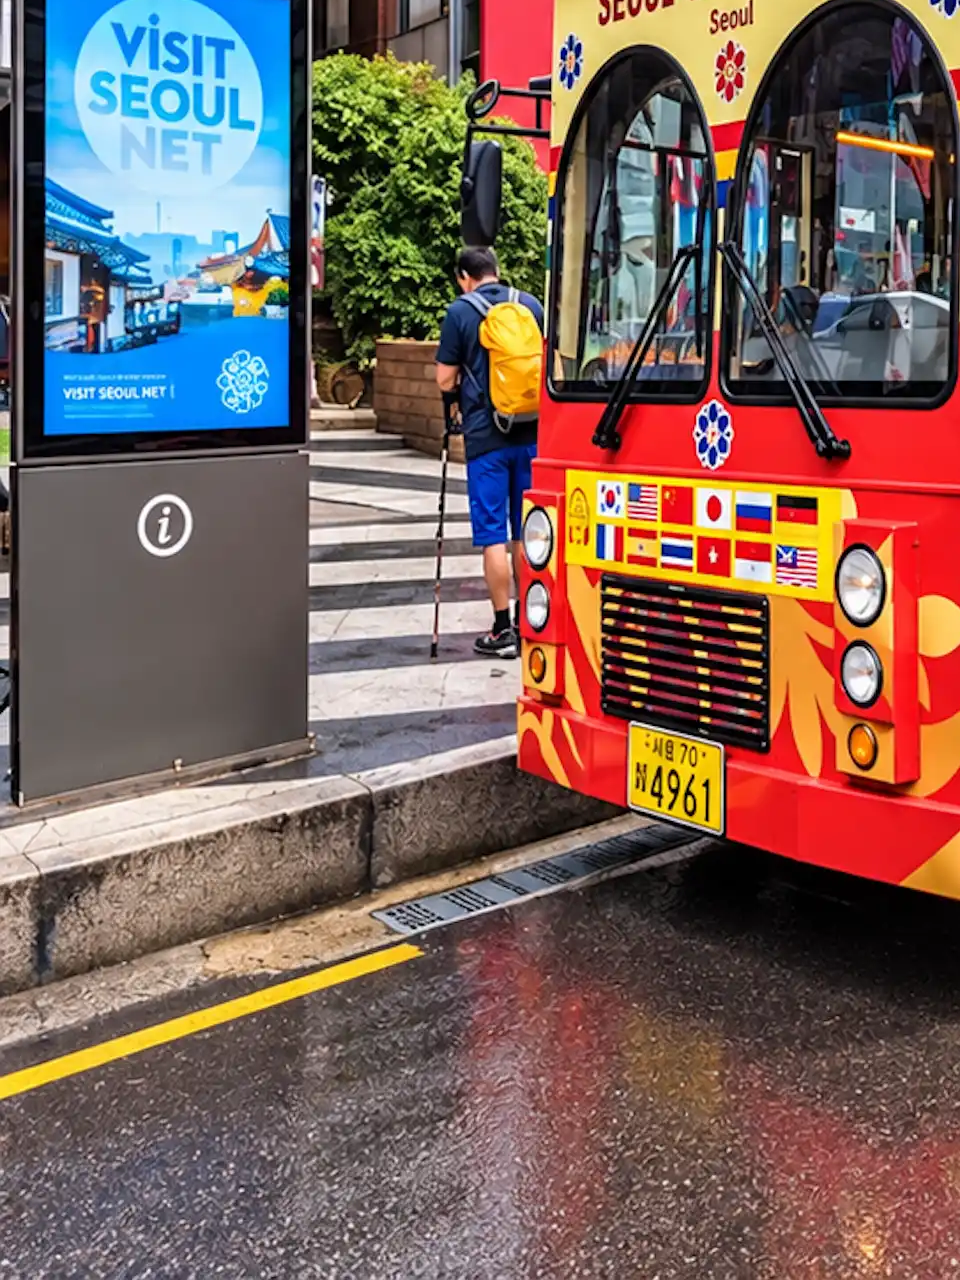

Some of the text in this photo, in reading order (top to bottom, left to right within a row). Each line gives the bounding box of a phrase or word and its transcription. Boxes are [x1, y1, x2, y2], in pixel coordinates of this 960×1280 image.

[709, 0, 754, 35] Seoul
[88, 70, 255, 132] SEOUL
[121, 123, 222, 175] NET
[62, 384, 167, 401] VISIT SEOUL NET
[650, 765, 711, 823] 4961
